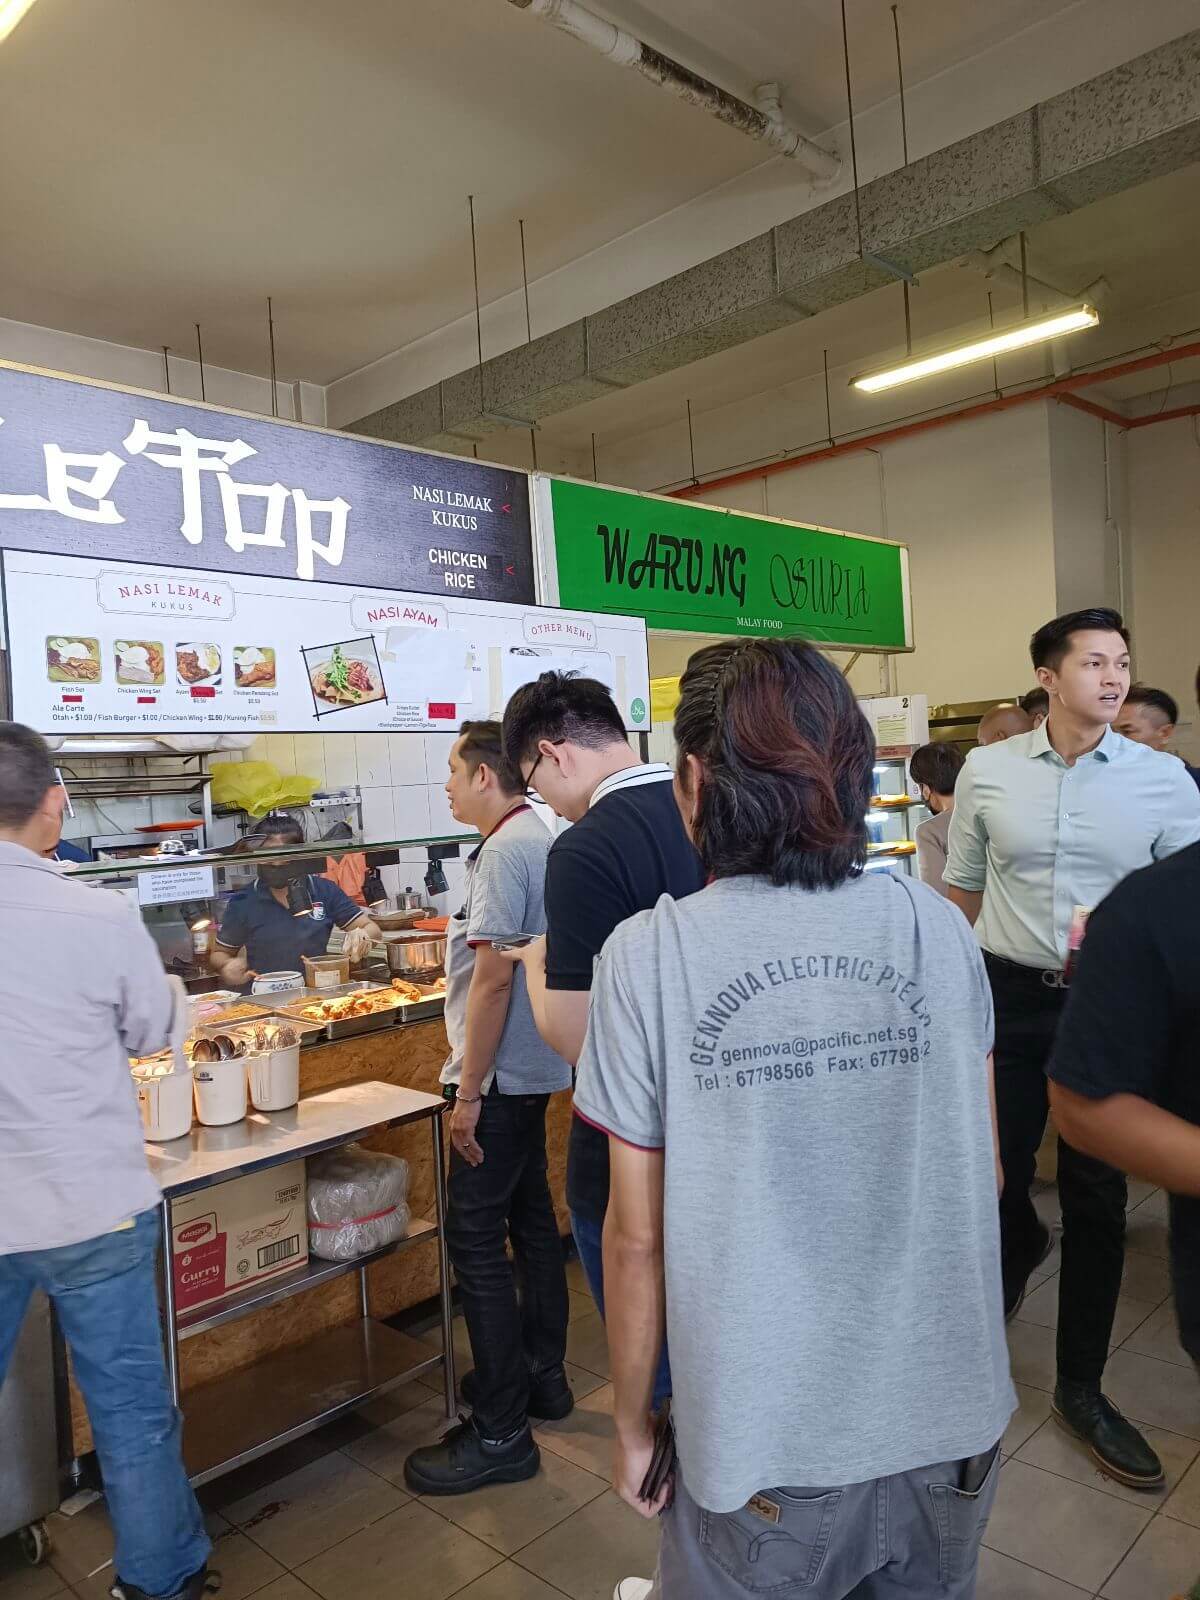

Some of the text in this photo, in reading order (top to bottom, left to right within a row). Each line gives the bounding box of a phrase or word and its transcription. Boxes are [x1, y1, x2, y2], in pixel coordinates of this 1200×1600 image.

[412, 485, 494, 513] NASI LEMAK
[431, 510, 478, 530] KUKUS
[428, 548, 488, 569] CHICKEN
[597, 524, 747, 608] WARUNG
[444, 571, 476, 589] RICE
[118, 583, 223, 606] NASI LEMAK
[151, 601, 193, 611] KUKUS
[367, 606, 438, 628] NASI AYAM
[736, 616, 783, 631] MALAY FOOD
[531, 623, 592, 641] OTHER MENU
[902, 697, 909, 708] 2
[98, 713, 113, 721] Fish
[113, 714, 137, 723] Burger
[689, 970, 766, 1067] GENNOVA
[763, 955, 875, 987] ELECTRIC
[875, 964, 917, 1002] PTE
[721, 1025, 918, 1067] gennova@pacific.net.sg
[694, 1073, 719, 1092] Tel
[736, 1061, 815, 1088] 67798566
[827, 1055, 864, 1074] Fax:
[180, 1264, 220, 1284] Curry
